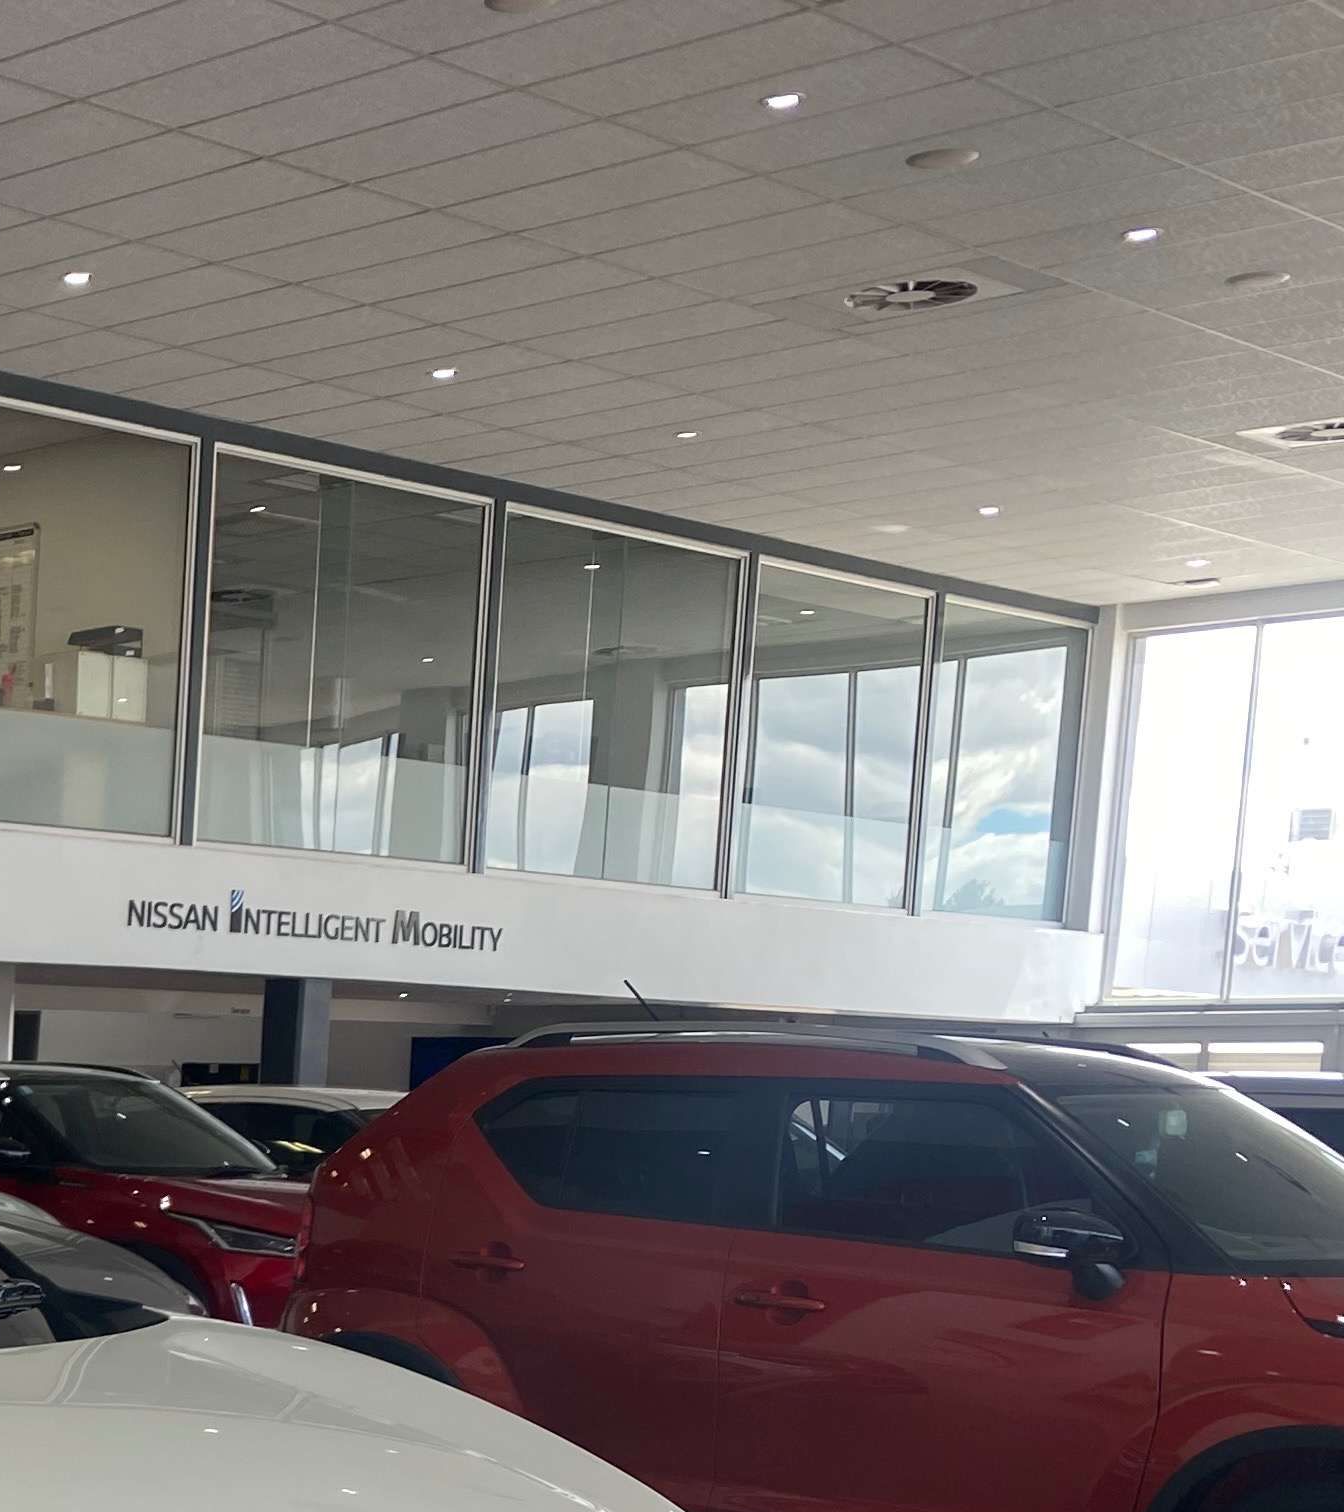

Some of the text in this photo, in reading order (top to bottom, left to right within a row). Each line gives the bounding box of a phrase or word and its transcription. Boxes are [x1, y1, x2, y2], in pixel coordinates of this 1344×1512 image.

[126, 889, 504, 952] NISSAN INTELLIGENT MOBILITY
